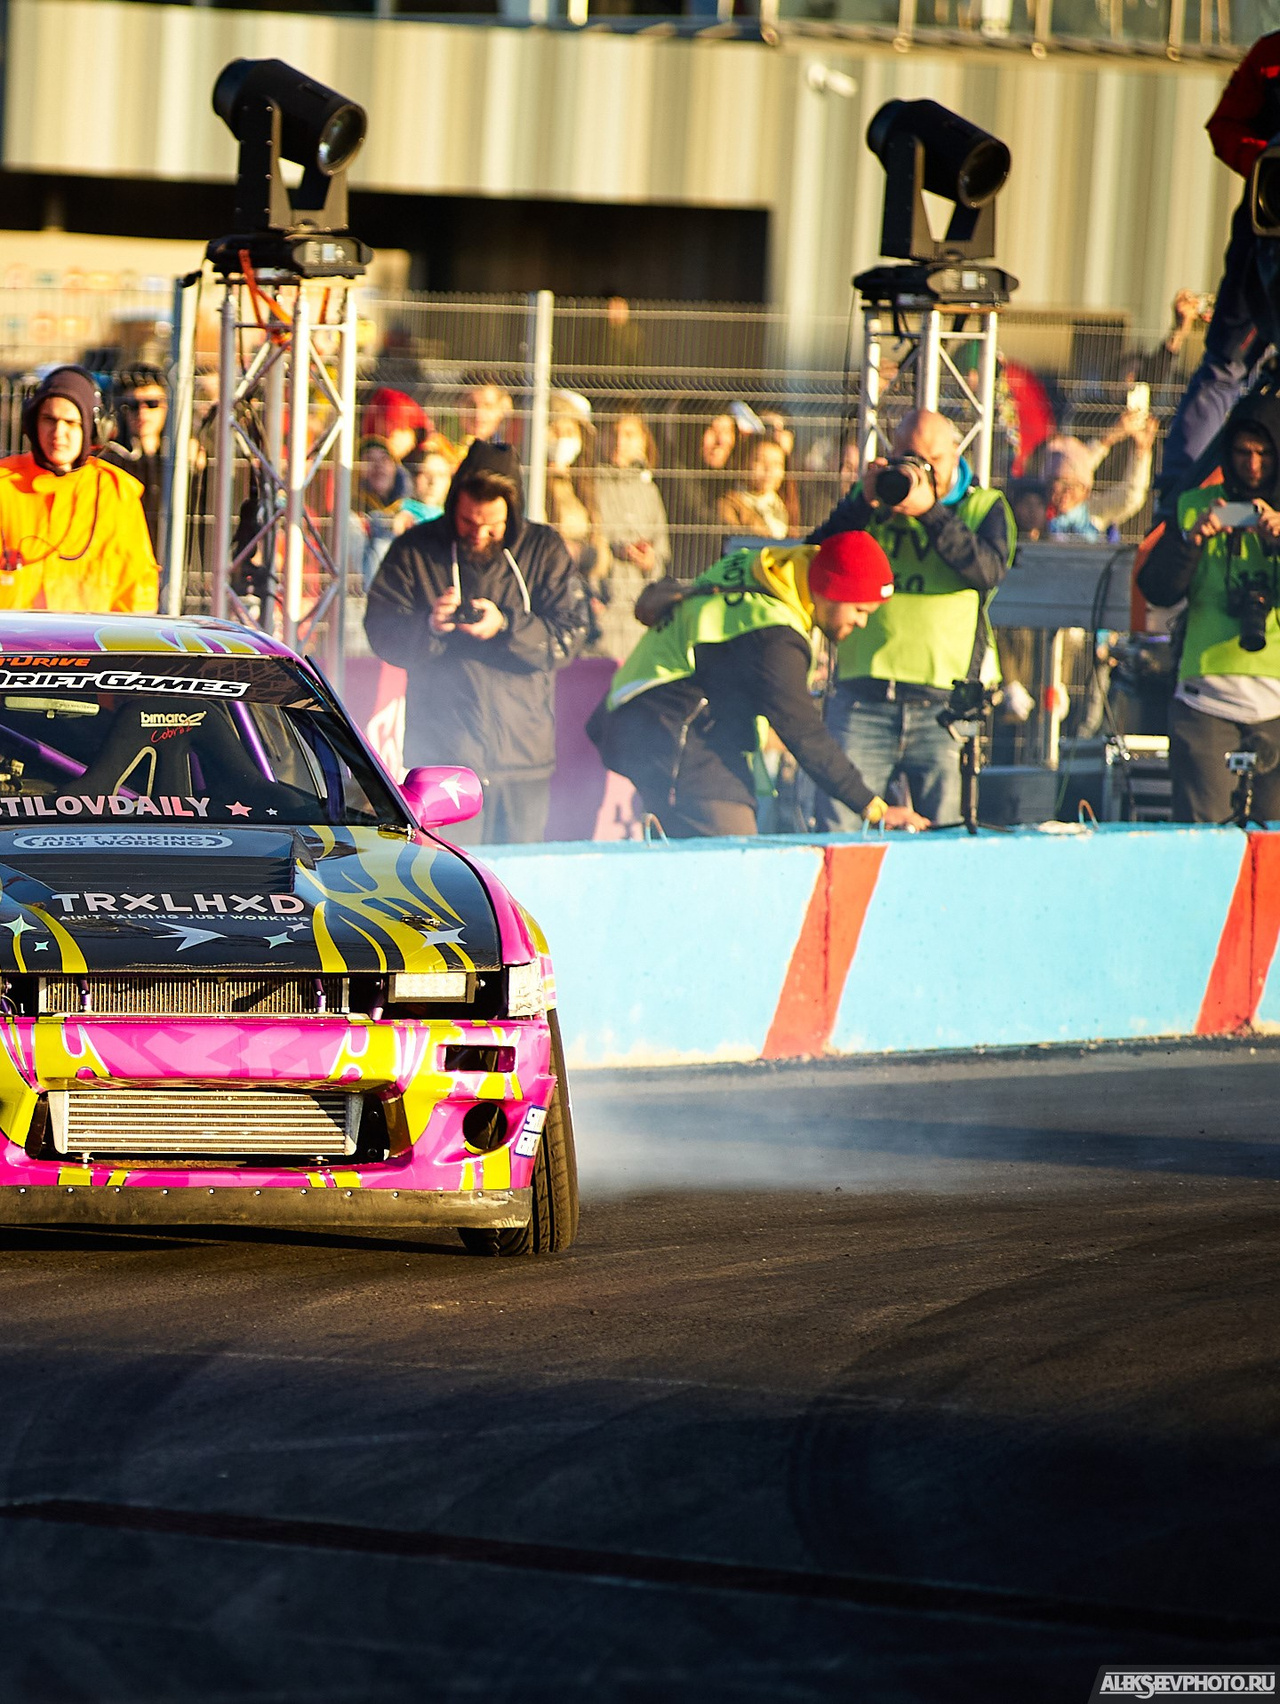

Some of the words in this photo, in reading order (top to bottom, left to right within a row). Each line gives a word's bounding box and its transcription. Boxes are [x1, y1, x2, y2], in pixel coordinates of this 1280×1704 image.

[140, 710, 207, 724] bimarco
[51, 893, 306, 914] TRXLHXD
[230, 914, 311, 922] WORKING
